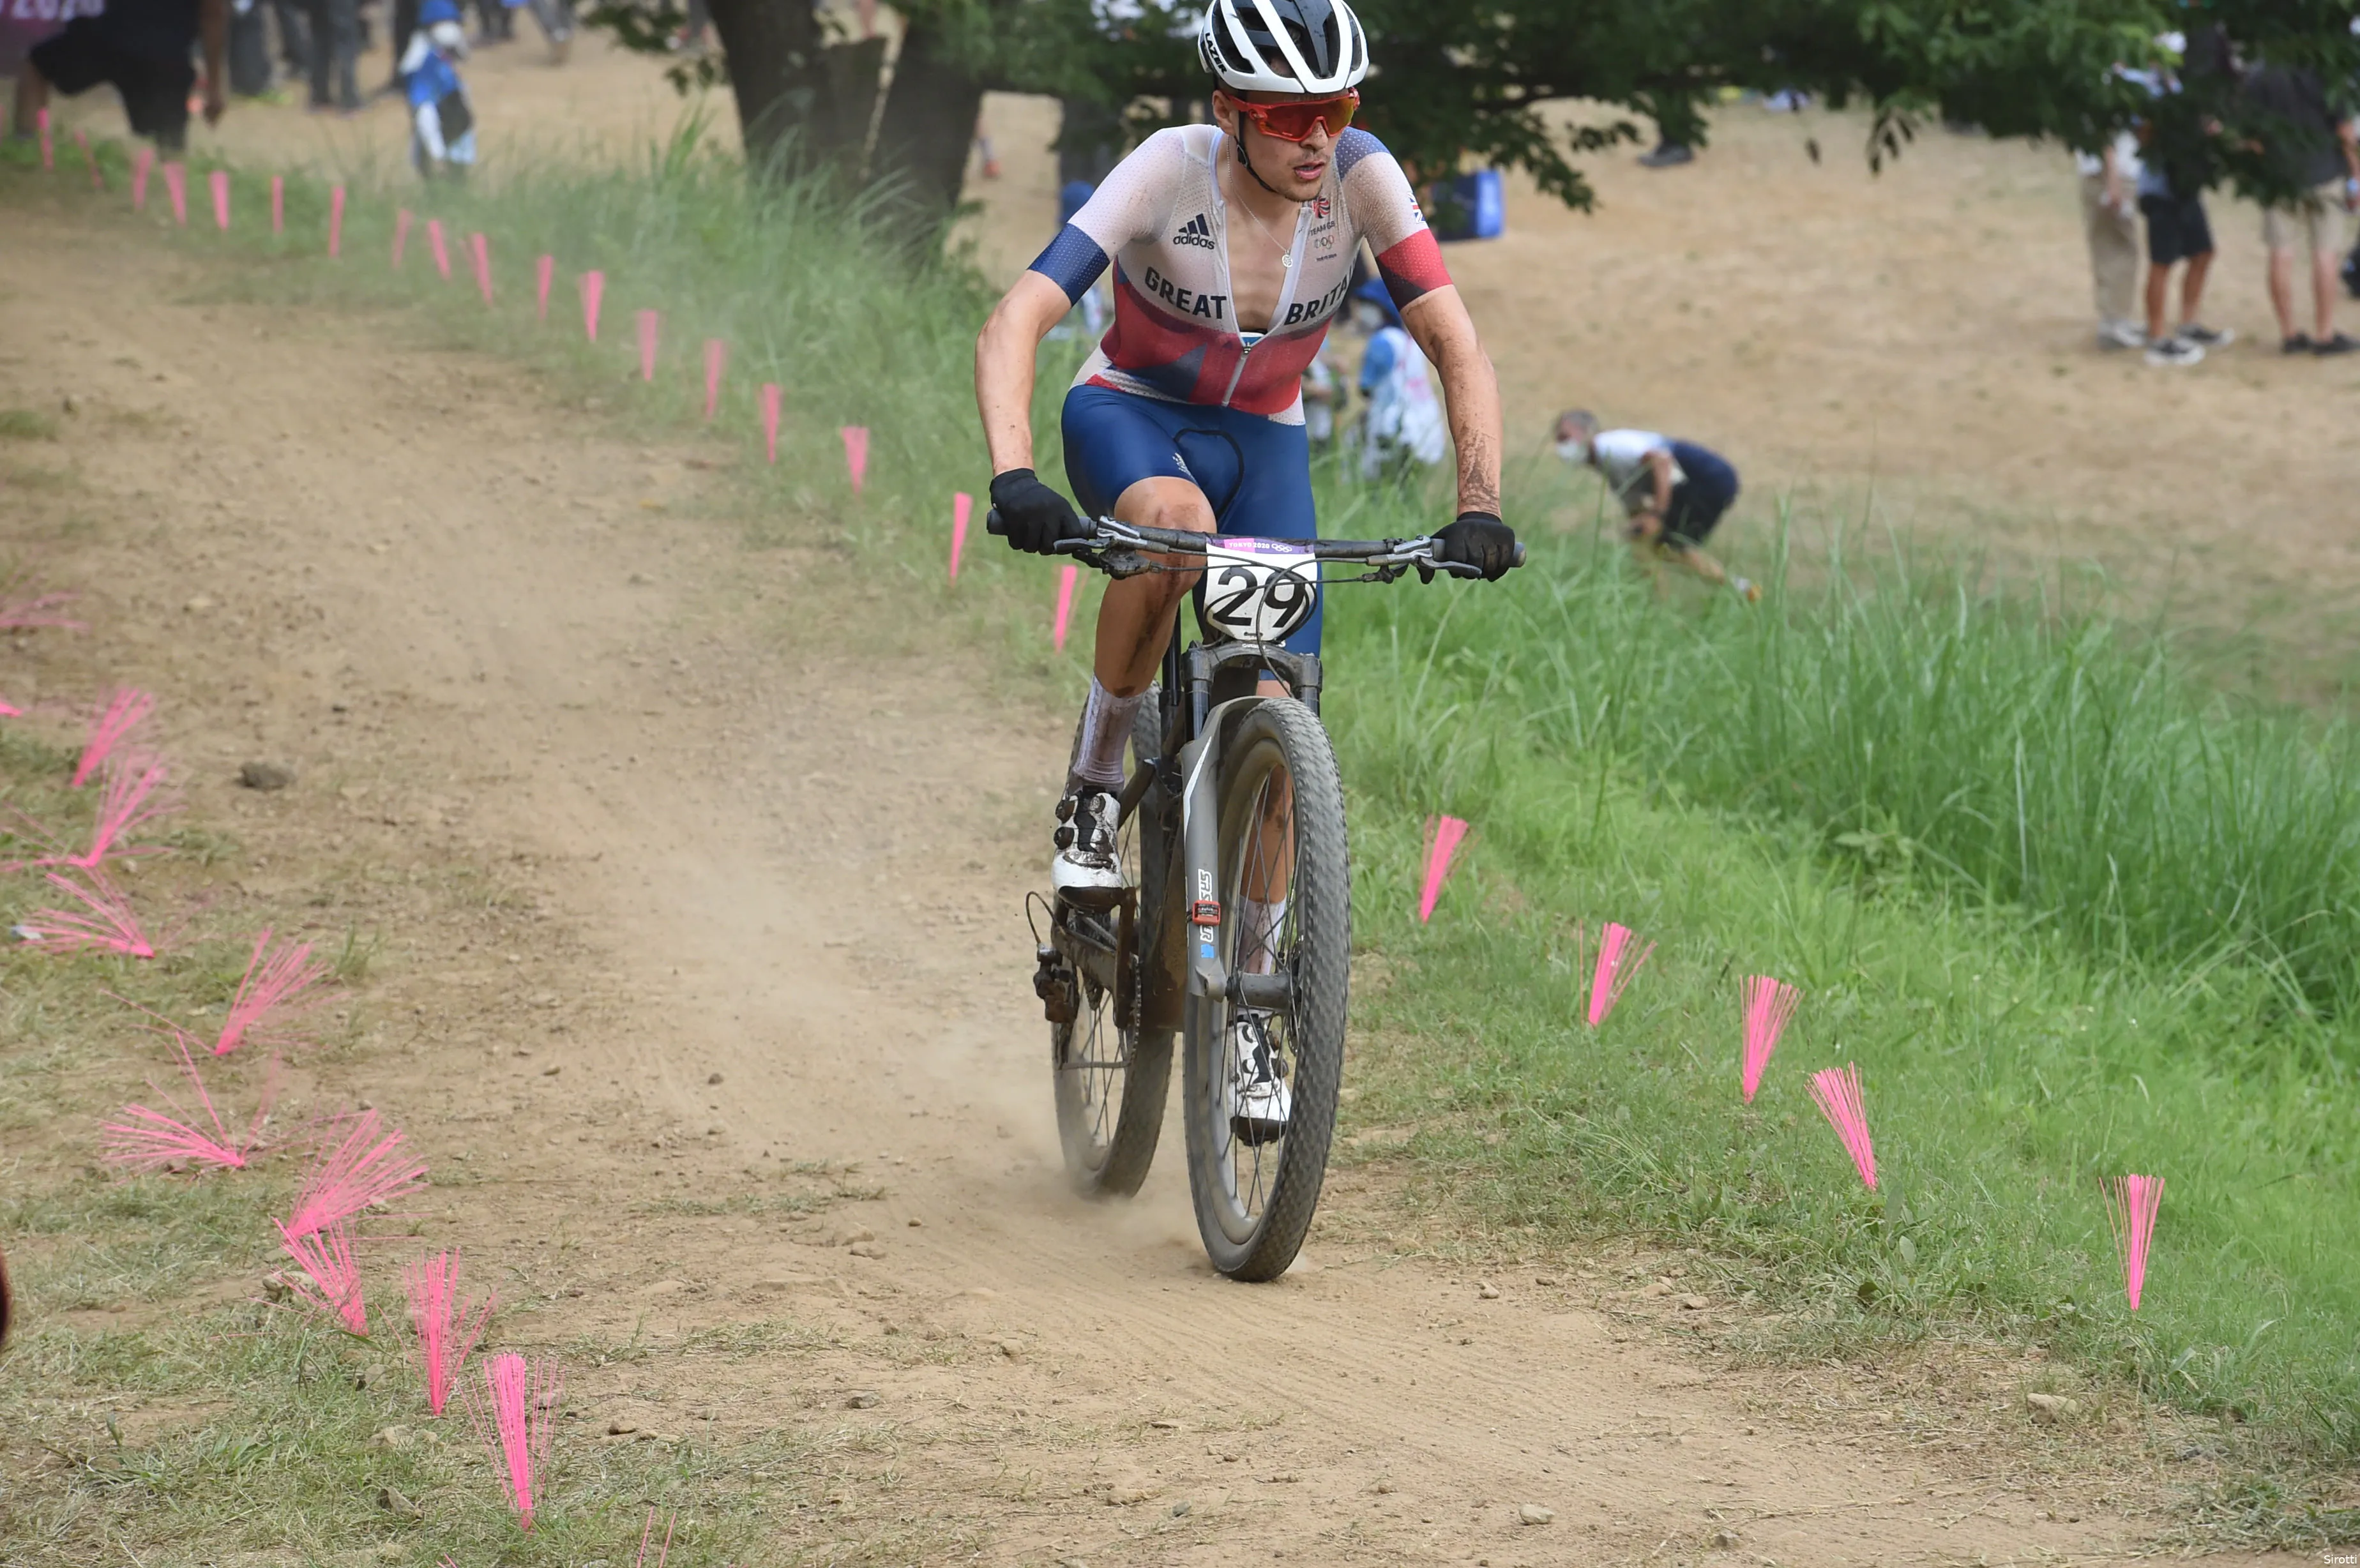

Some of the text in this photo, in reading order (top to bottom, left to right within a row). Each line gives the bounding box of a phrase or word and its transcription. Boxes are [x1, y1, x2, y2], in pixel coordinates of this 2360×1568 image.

[1205, 33, 1227, 75] LAZER
[1173, 233, 1215, 250] adidas
[1309, 223, 1326, 236] TEAM
[1145, 257, 1356, 326] GREAT BRITAI
[1213, 566, 1306, 628] 29
